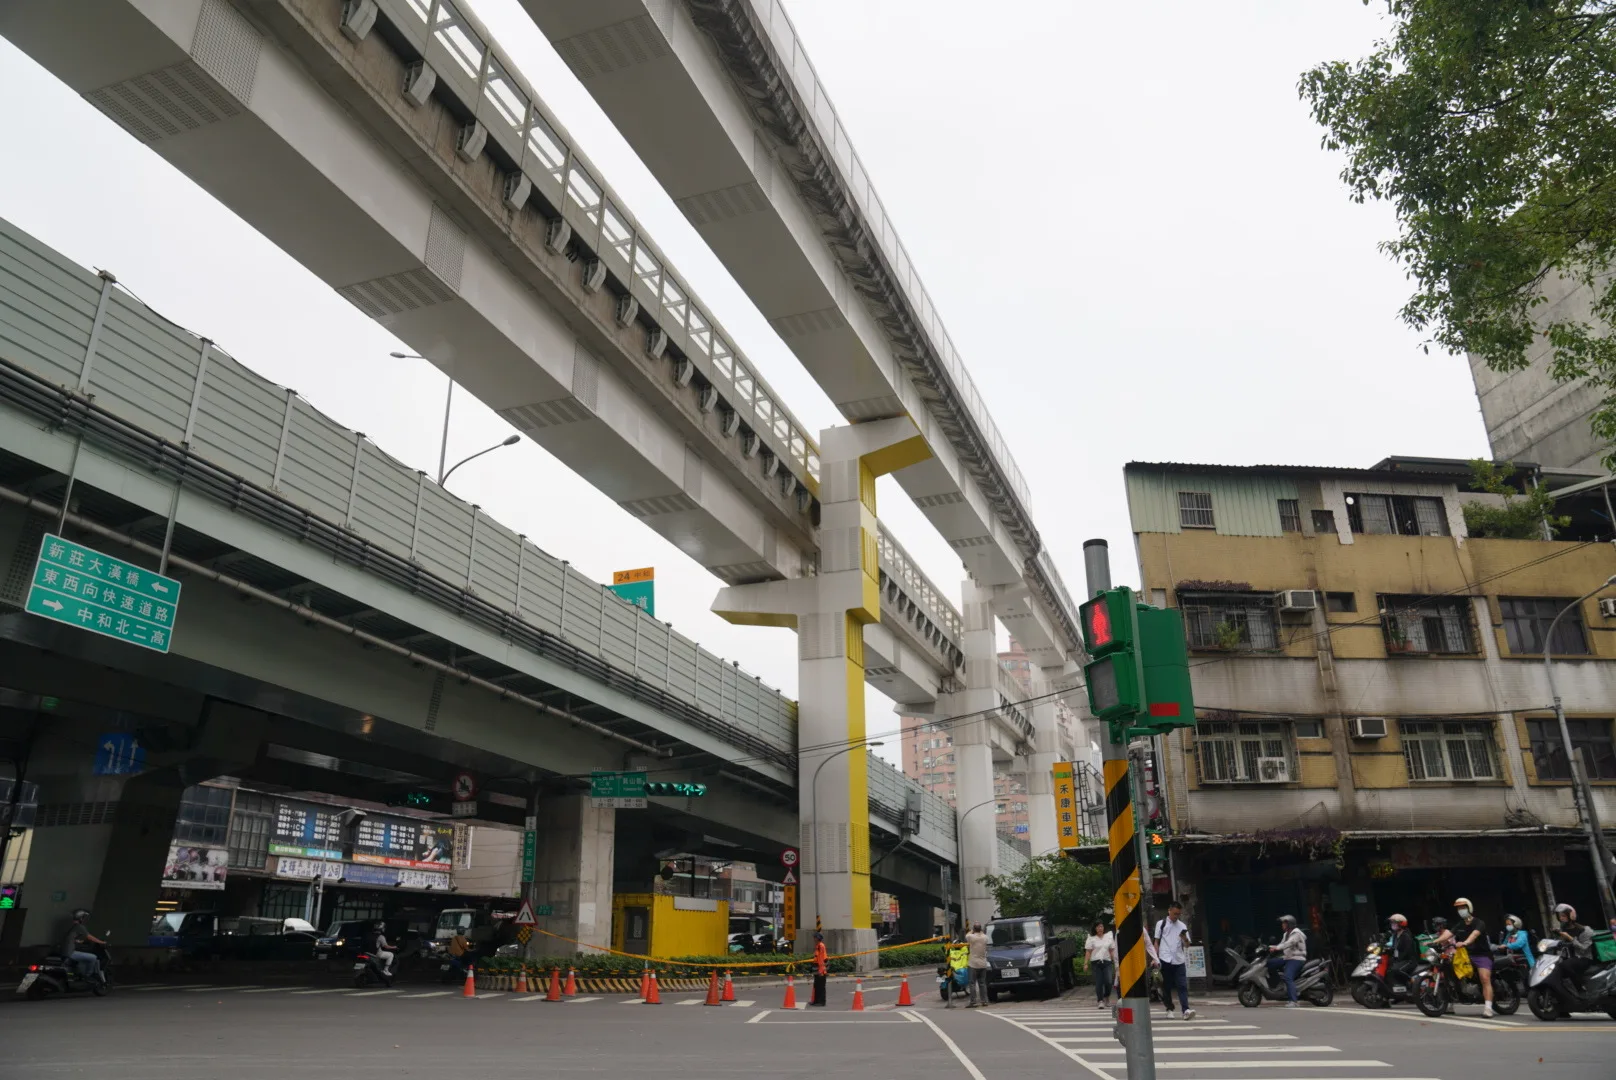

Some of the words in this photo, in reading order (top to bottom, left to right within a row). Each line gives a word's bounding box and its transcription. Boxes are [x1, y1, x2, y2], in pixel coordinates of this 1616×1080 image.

[48, 542, 140, 588] 新莊大漢橋
[617, 572, 630, 582] 24
[44, 567, 169, 622] 東西向快速道路
[77, 607, 166, 646] 中和北二高
[1060, 784, 1073, 836] 禾康車業
